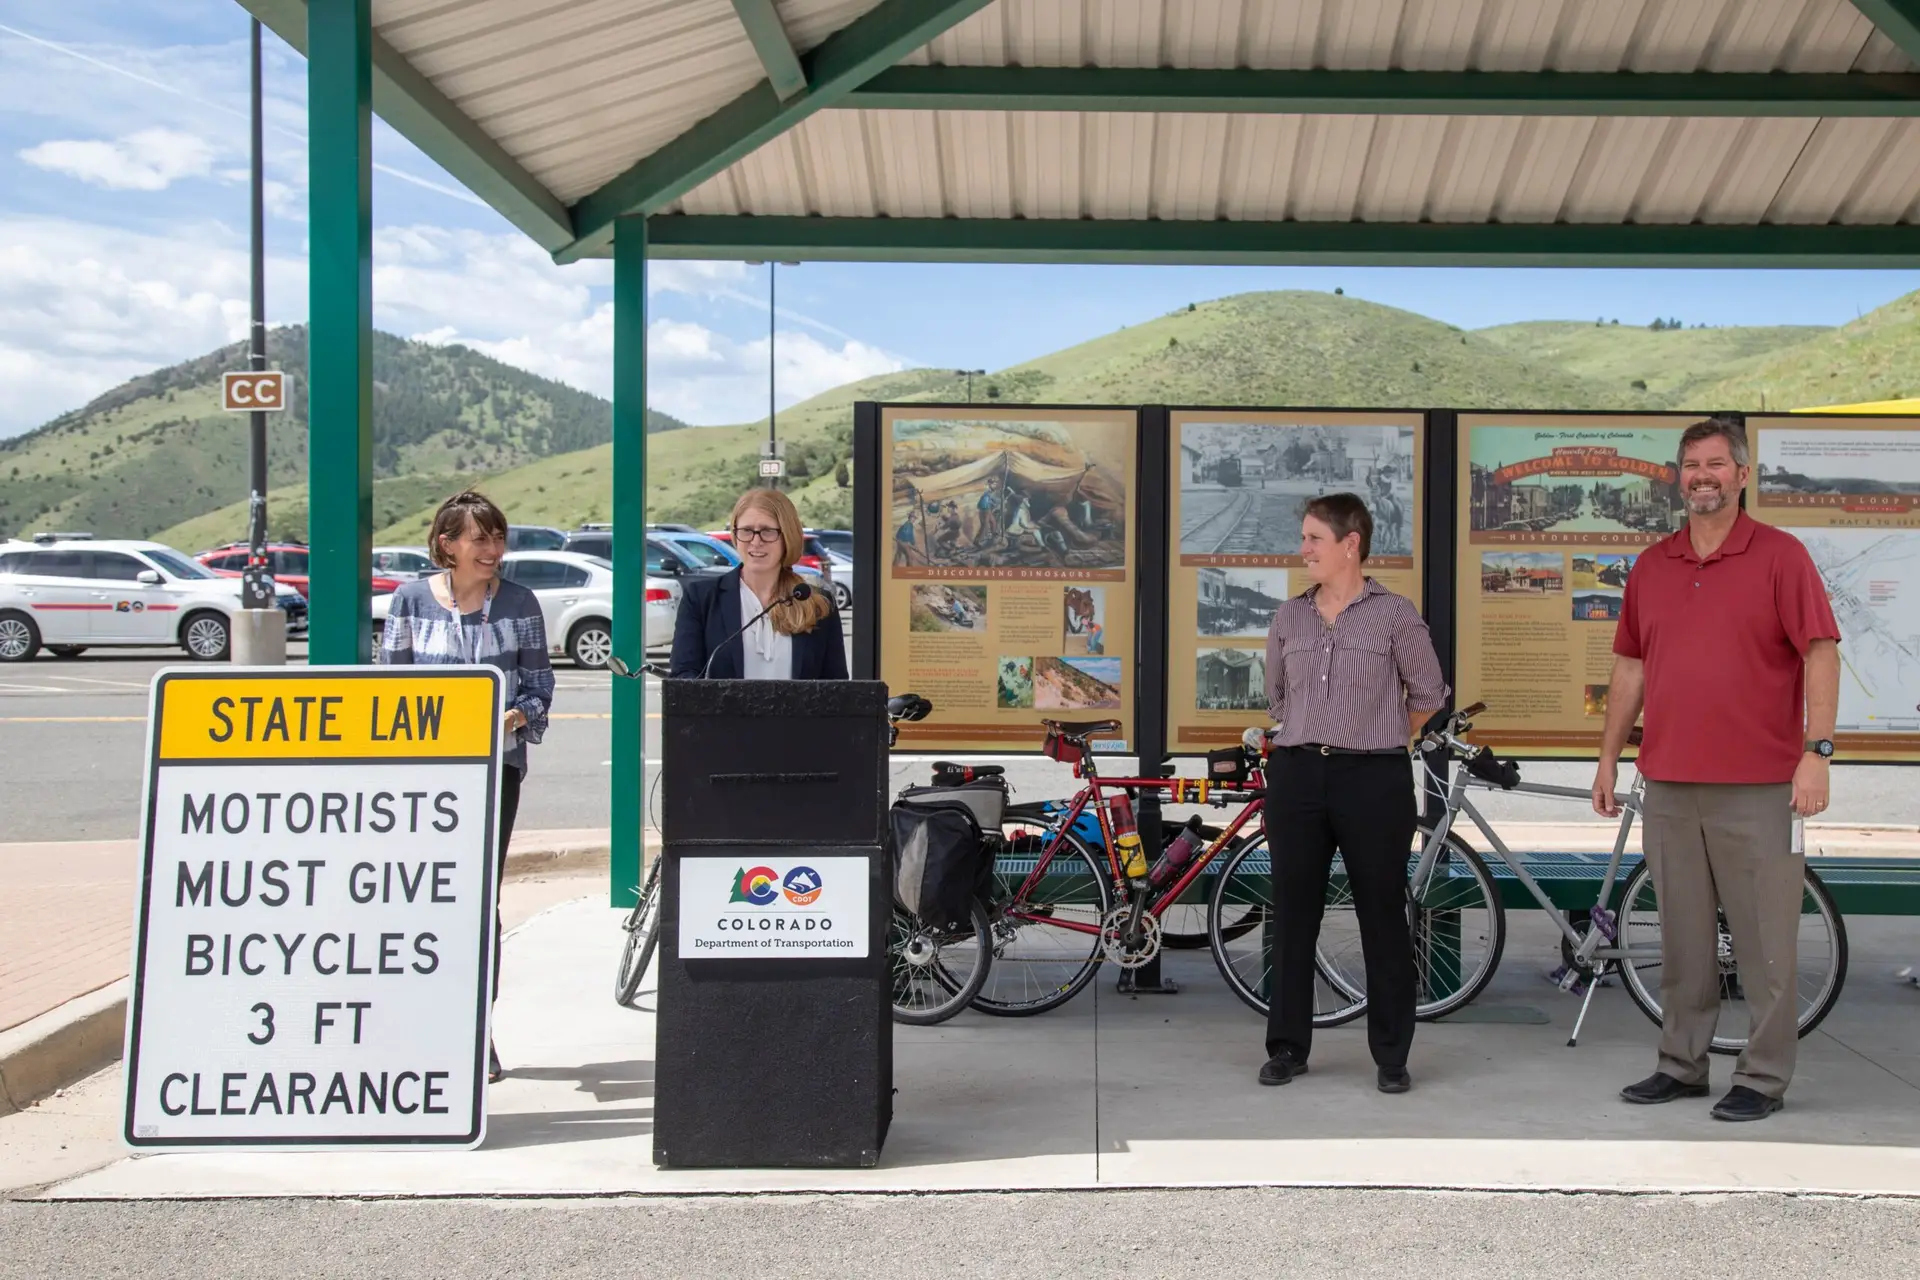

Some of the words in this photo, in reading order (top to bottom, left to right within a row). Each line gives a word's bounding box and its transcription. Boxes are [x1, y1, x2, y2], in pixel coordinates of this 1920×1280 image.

[231, 379, 276, 403] CC
[1502, 456, 1574, 478] WELCOME
[1582, 455, 1603, 467] TO
[1608, 457, 1669, 479] GOLDEN
[1787, 496, 1847, 504] LARIAT
[1859, 496, 1900, 504] LOOP
[1509, 534, 1589, 542] HISTORIC
[1601, 534, 1663, 542] GOLDEN
[1210, 557, 1289, 565] HISTORIC
[927, 569, 1014, 578] DISCOVERING
[1021, 570, 1092, 579] DINOSAURS
[208, 695, 343, 743] STATE
[370, 695, 444, 741] LAW
[181, 791, 460, 834] MOTORISTS
[175, 859, 326, 907] MUST
[348, 861, 457, 904] GIVE
[717, 918, 833, 931] COLORADO
[185, 932, 440, 976] BICYCLES
[695, 938, 758, 950] Department
[760, 938, 773, 948] of
[774, 938, 854, 950] Transportation
[247, 1001, 275, 1045] 3
[313, 1001, 372, 1045] FT
[159, 1071, 450, 1117] CLEARANCE
